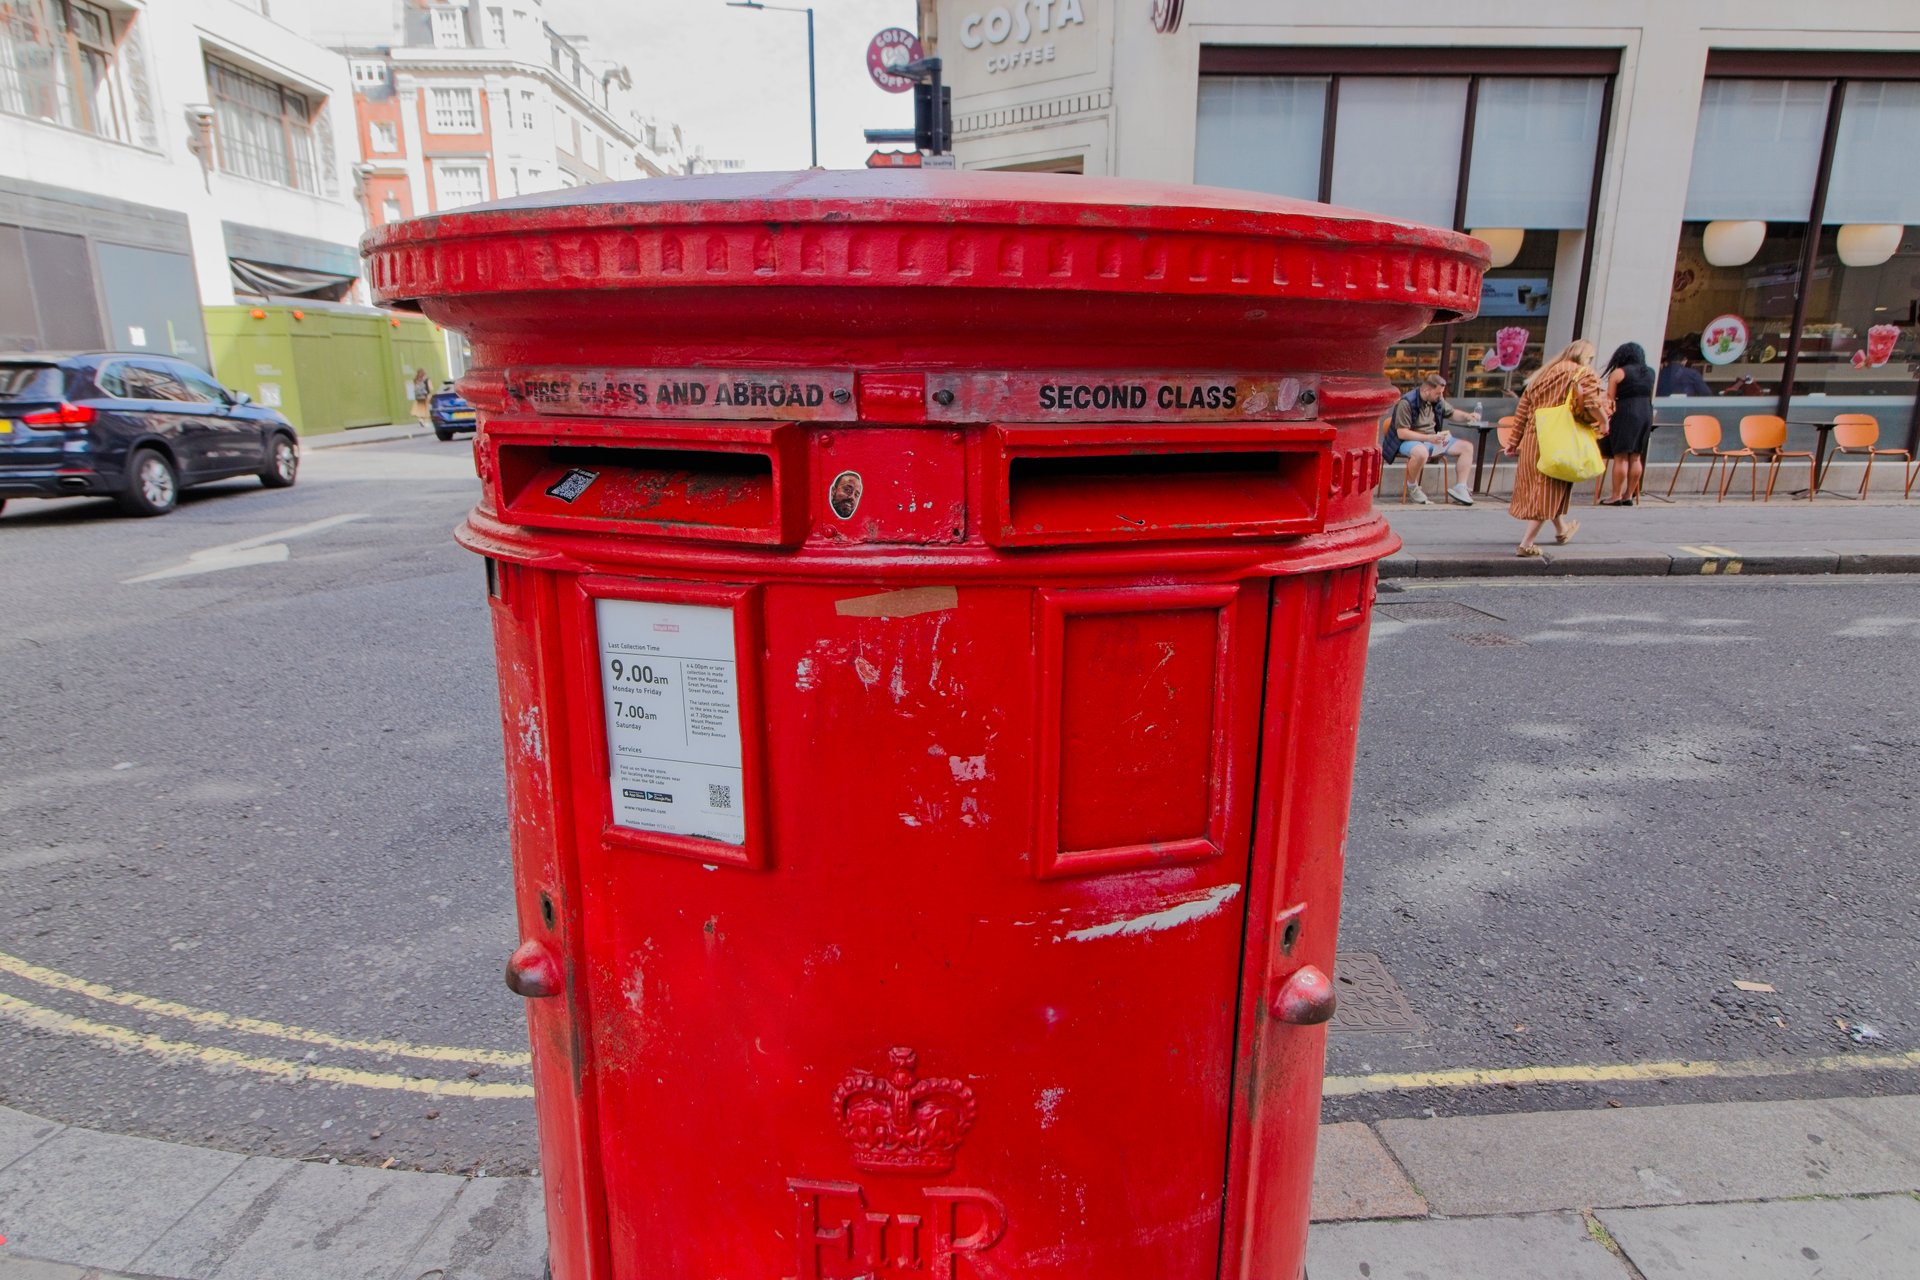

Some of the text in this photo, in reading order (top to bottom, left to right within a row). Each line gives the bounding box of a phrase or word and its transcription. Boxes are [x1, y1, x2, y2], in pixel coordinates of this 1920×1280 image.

[960, 0, 1084, 49] COSTA
[876, 30, 914, 48] COSTA
[986, 46, 1056, 75] COFFEE
[525, 381, 824, 407] FIRST CLASS AND ABROAD
[1039, 385, 1236, 409] SECOND CLASS
[611, 659, 668, 684] 9.00am
[612, 685, 634, 694] Monday
[644, 688, 662, 696] Friday
[614, 702, 657, 720] 7.00am
[616, 721, 642, 730] Saturday
[618, 744, 642, 754] Services
[624, 805, 666, 815] www.royalmail.com
